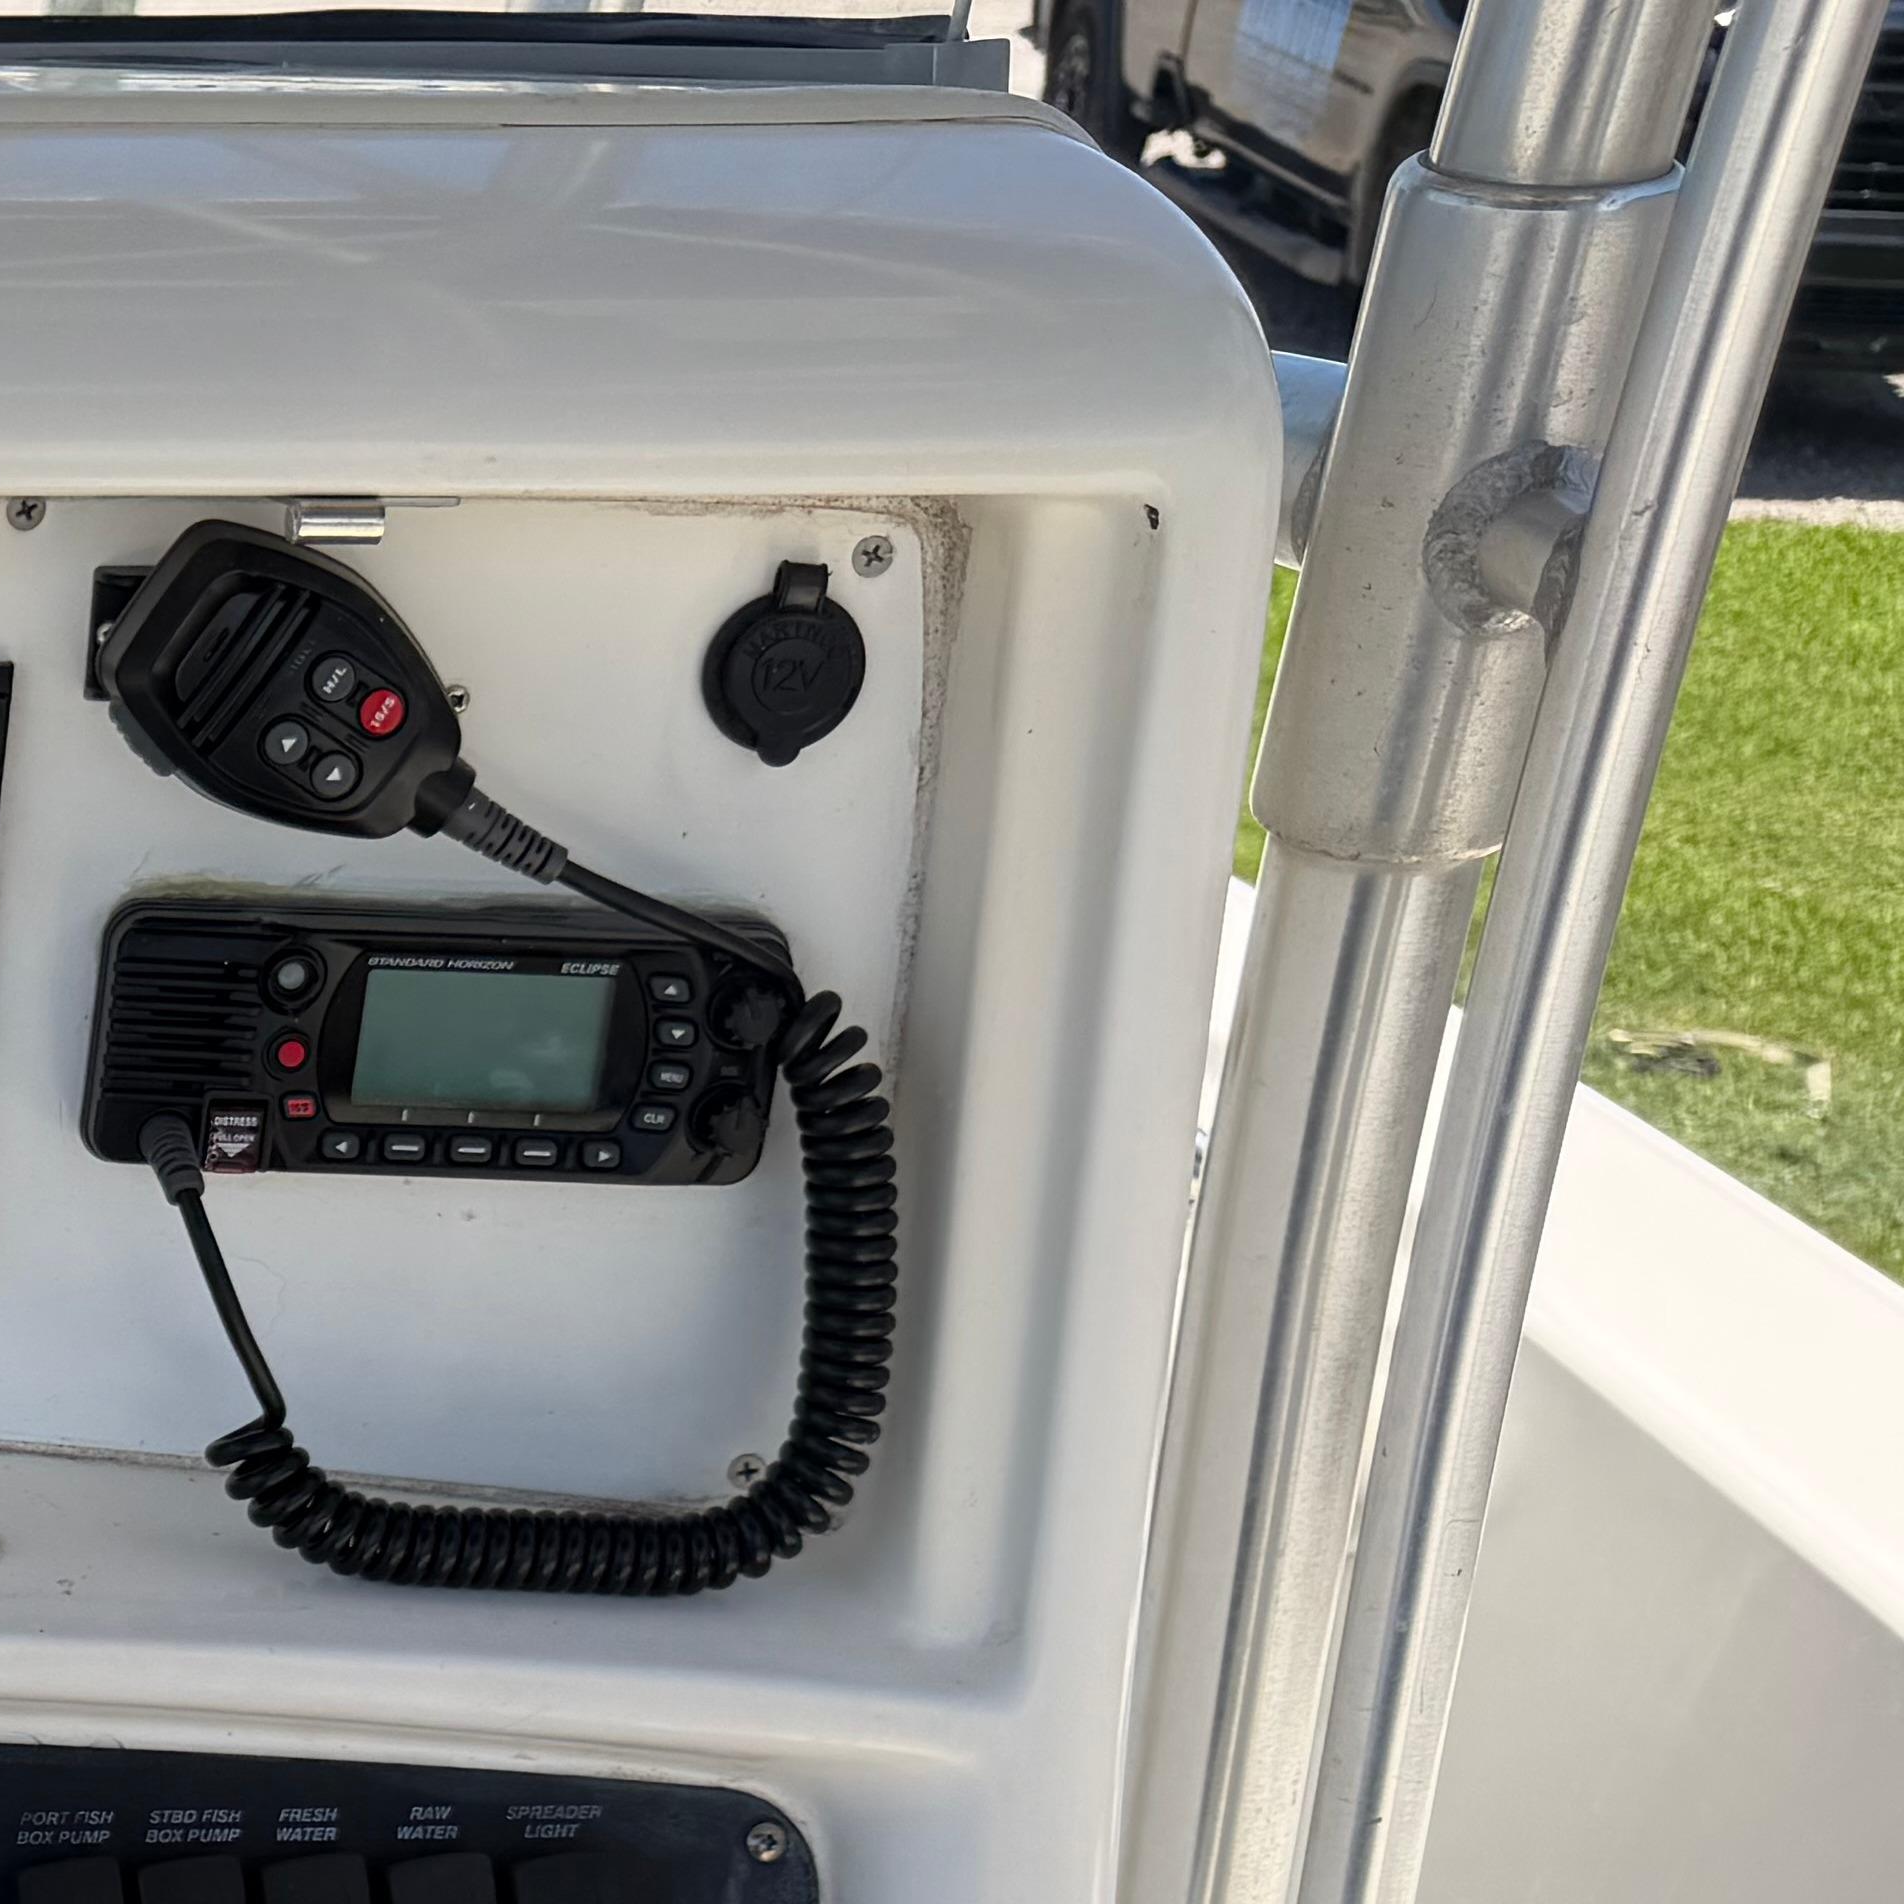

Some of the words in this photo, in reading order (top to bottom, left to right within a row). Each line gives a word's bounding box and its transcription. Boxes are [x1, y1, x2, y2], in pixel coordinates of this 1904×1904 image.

[322, 666, 348, 695] H/L
[761, 657, 826, 692] 12V
[368, 956, 443, 969] STANDARD
[447, 959, 514, 971] HORIZON
[561, 962, 620, 976] ECLIPSE
[660, 1072, 684, 1084] MENU
[214, 1116, 258, 1127] DISTRESS
[644, 1112, 665, 1124] CLR
[19, 1810, 71, 1827] PORT
[73, 1809, 115, 1825] FISH
[148, 1809, 198, 1825] STBD
[200, 1808, 243, 1824] FISH
[278, 1807, 339, 1824] FRESH
[409, 1806, 452, 1822] RAW
[505, 1804, 603, 1821] SPREADER
[16, 1829, 56, 1846] BOX
[57, 1829, 111, 1845] PUMP
[144, 1828, 185, 1844] BOX
[186, 1828, 243, 1844] PUMP
[275, 1827, 339, 1843] WATER
[396, 1825, 460, 1841] WATER
[523, 1823, 581, 1840] LIGHT
